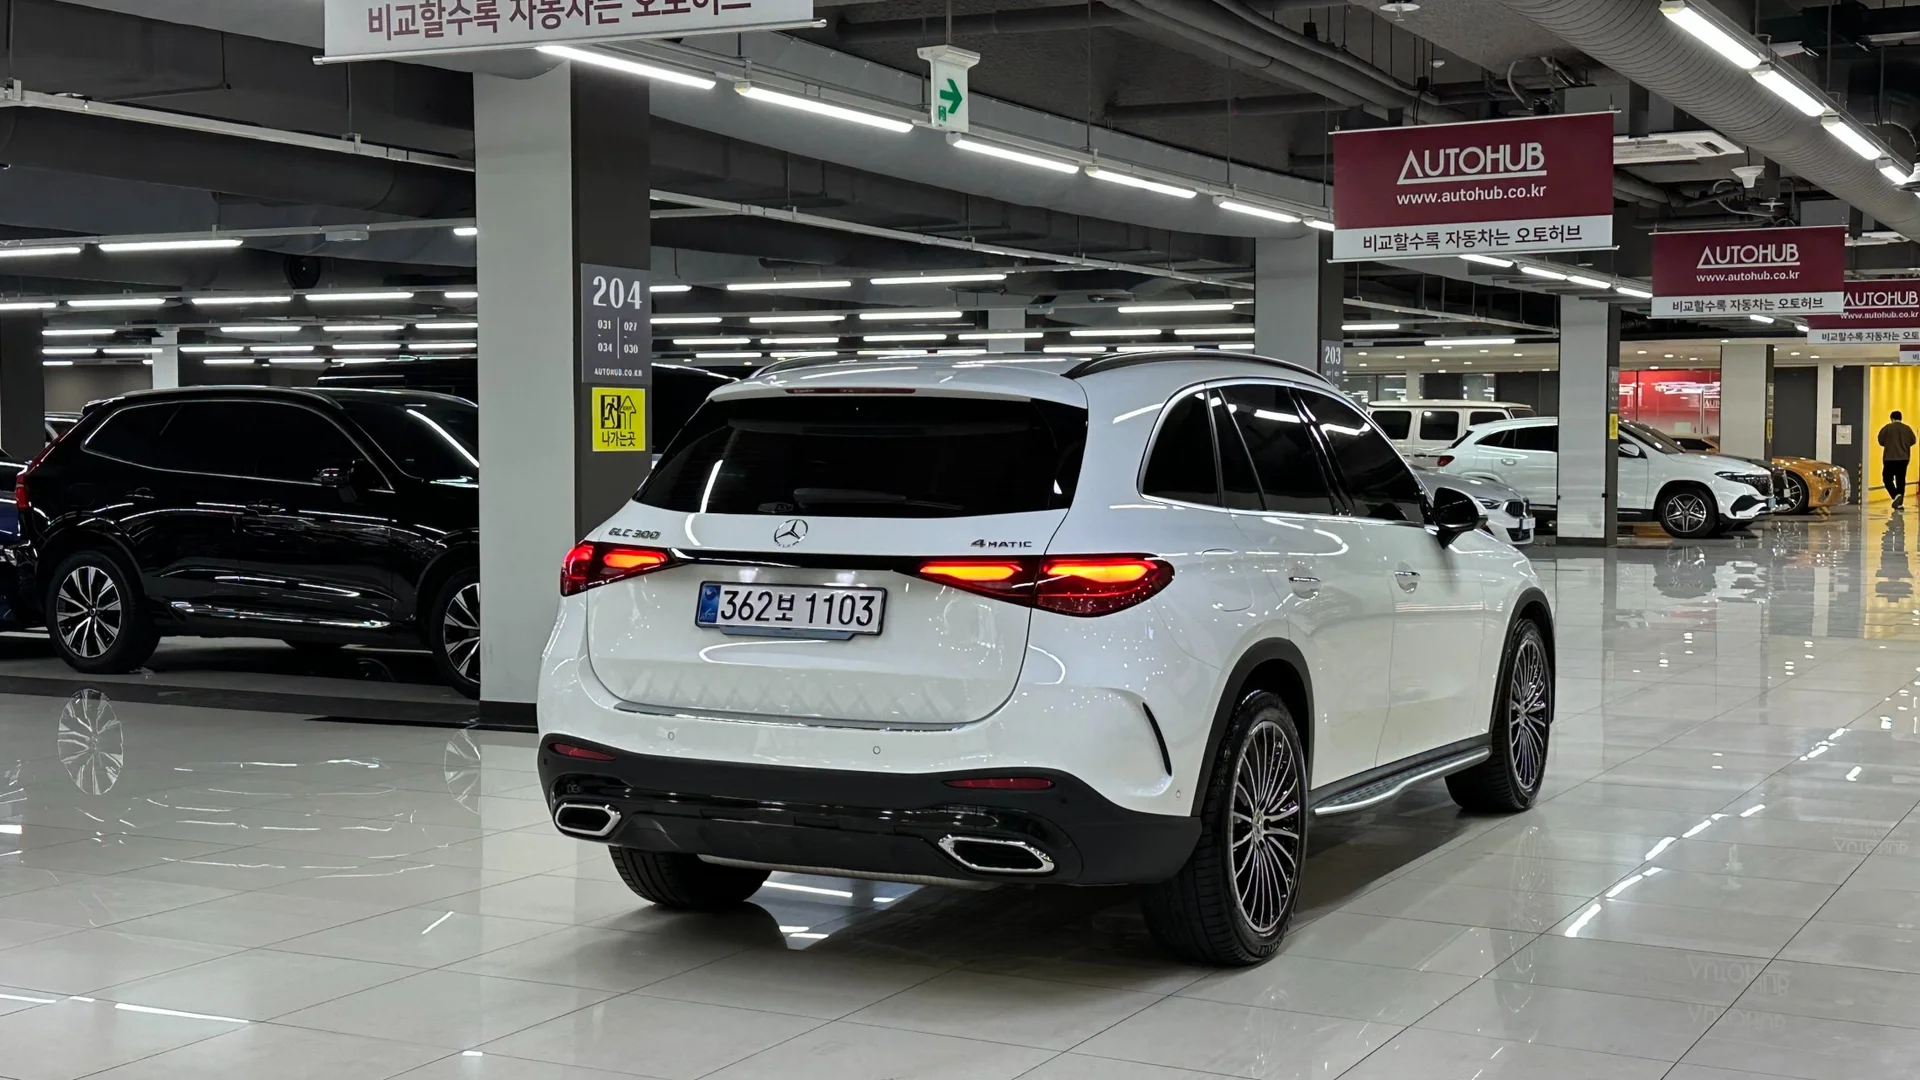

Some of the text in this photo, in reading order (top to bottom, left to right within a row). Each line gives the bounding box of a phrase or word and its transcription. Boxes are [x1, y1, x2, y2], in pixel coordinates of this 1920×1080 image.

[368, 0, 500, 40] 비교할수록
[1397, 142, 1547, 185] AUTOHUB
[1397, 184, 1546, 205] www.autohub.co.kr
[1363, 225, 1582, 252] 비교할수록 자동차는 오토허브
[1697, 243, 1800, 268] AUTOHUB
[1696, 270, 1800, 282] www.autohub.co.kr
[592, 275, 643, 310] 204
[1844, 291, 1919, 308] AUTOHUB
[1672, 297, 1824, 313] 비교할수록 자동차는 오토허브
[597, 319, 611, 330] 031
[623, 321, 637, 332] 027
[597, 342, 613, 352] 034
[623, 344, 639, 354] 030
[1325, 346, 1341, 365] 203
[602, 430, 636, 447] 나가는곳
[632, 529, 661, 540] 300
[970, 538, 1032, 548] 4MATIC
[720, 590, 876, 626] 362보 1103
